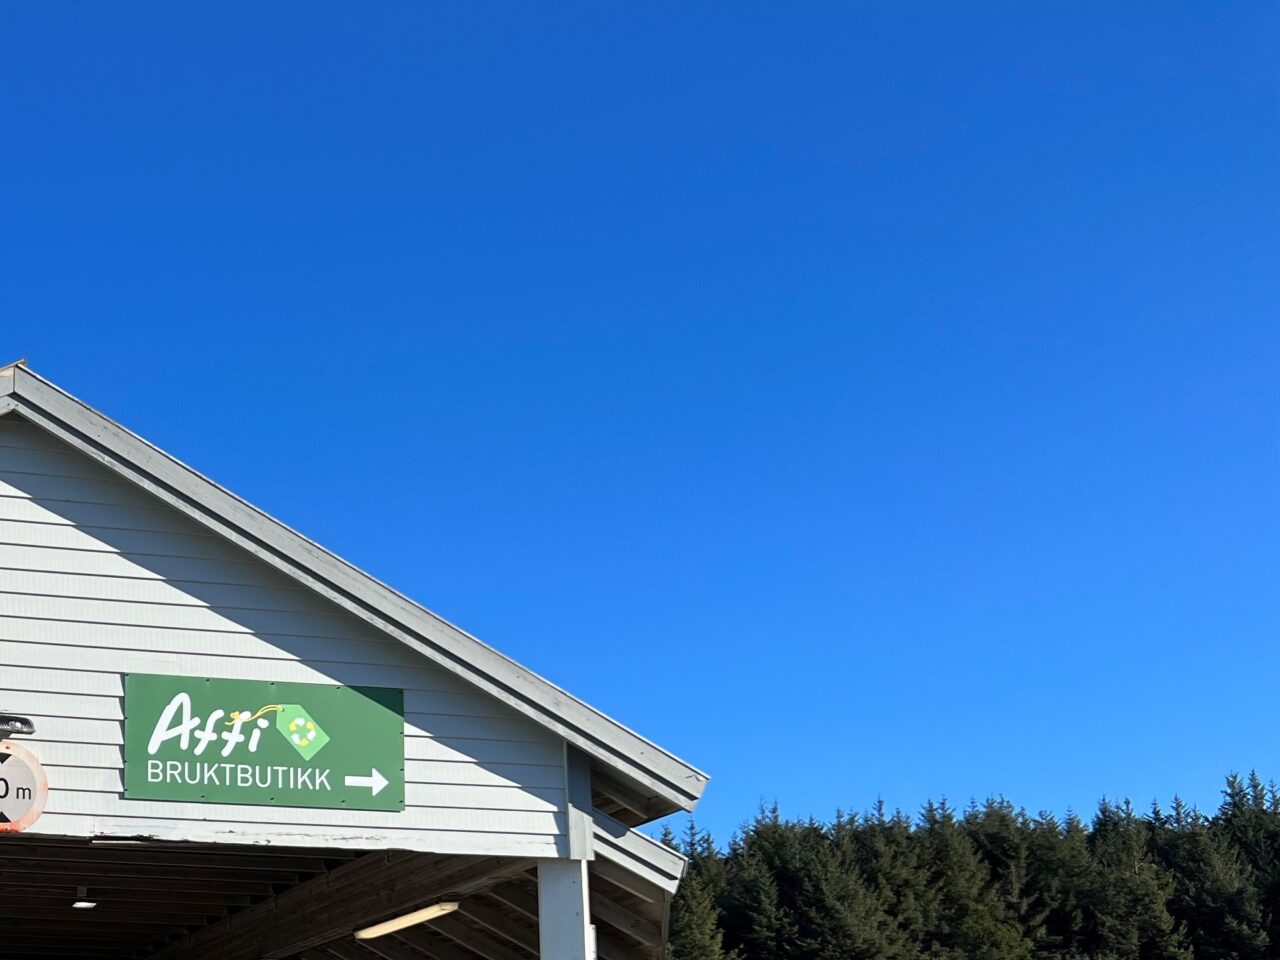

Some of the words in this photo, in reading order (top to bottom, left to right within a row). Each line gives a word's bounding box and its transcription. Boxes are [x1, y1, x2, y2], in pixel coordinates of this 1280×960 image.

[147, 692, 269, 757] Affi
[147, 759, 332, 791] BRUKTBUTIKK
[16, 787, 32, 800] m
